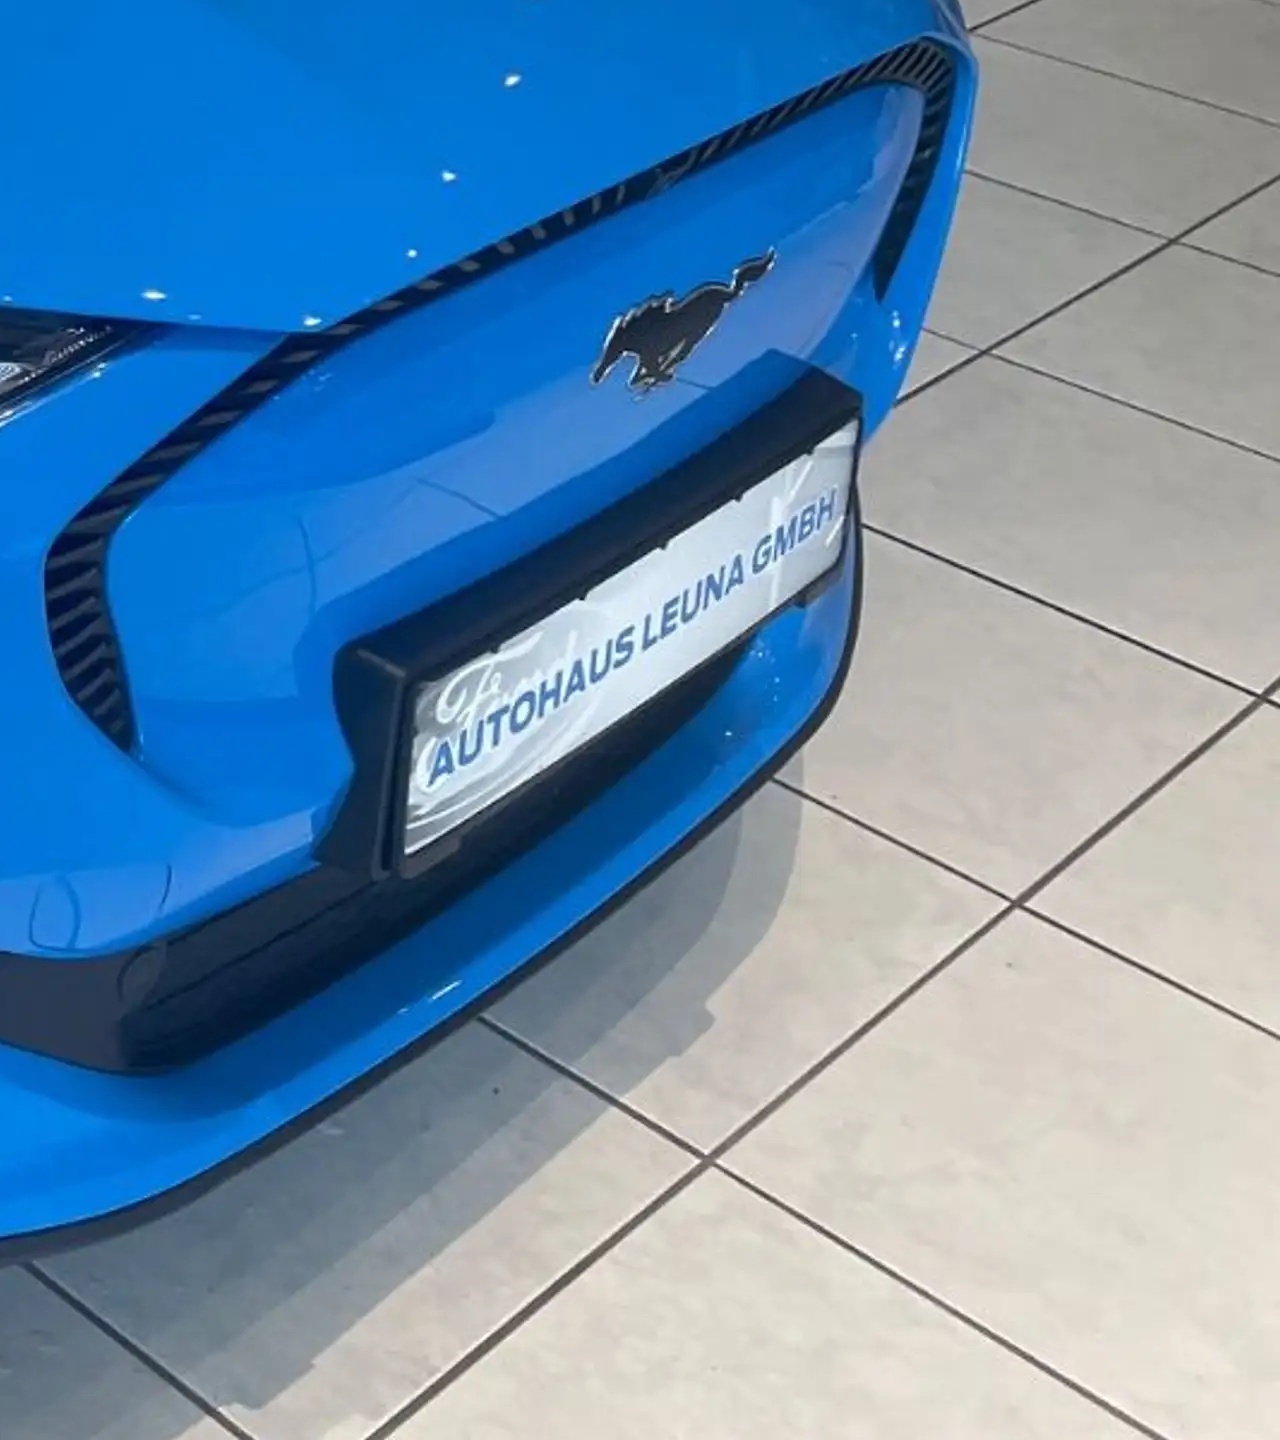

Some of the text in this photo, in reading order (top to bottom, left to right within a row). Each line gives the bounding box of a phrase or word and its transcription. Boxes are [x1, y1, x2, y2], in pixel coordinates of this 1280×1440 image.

[428, 487, 838, 788] AUTOHAUS LEUNA GMBH
